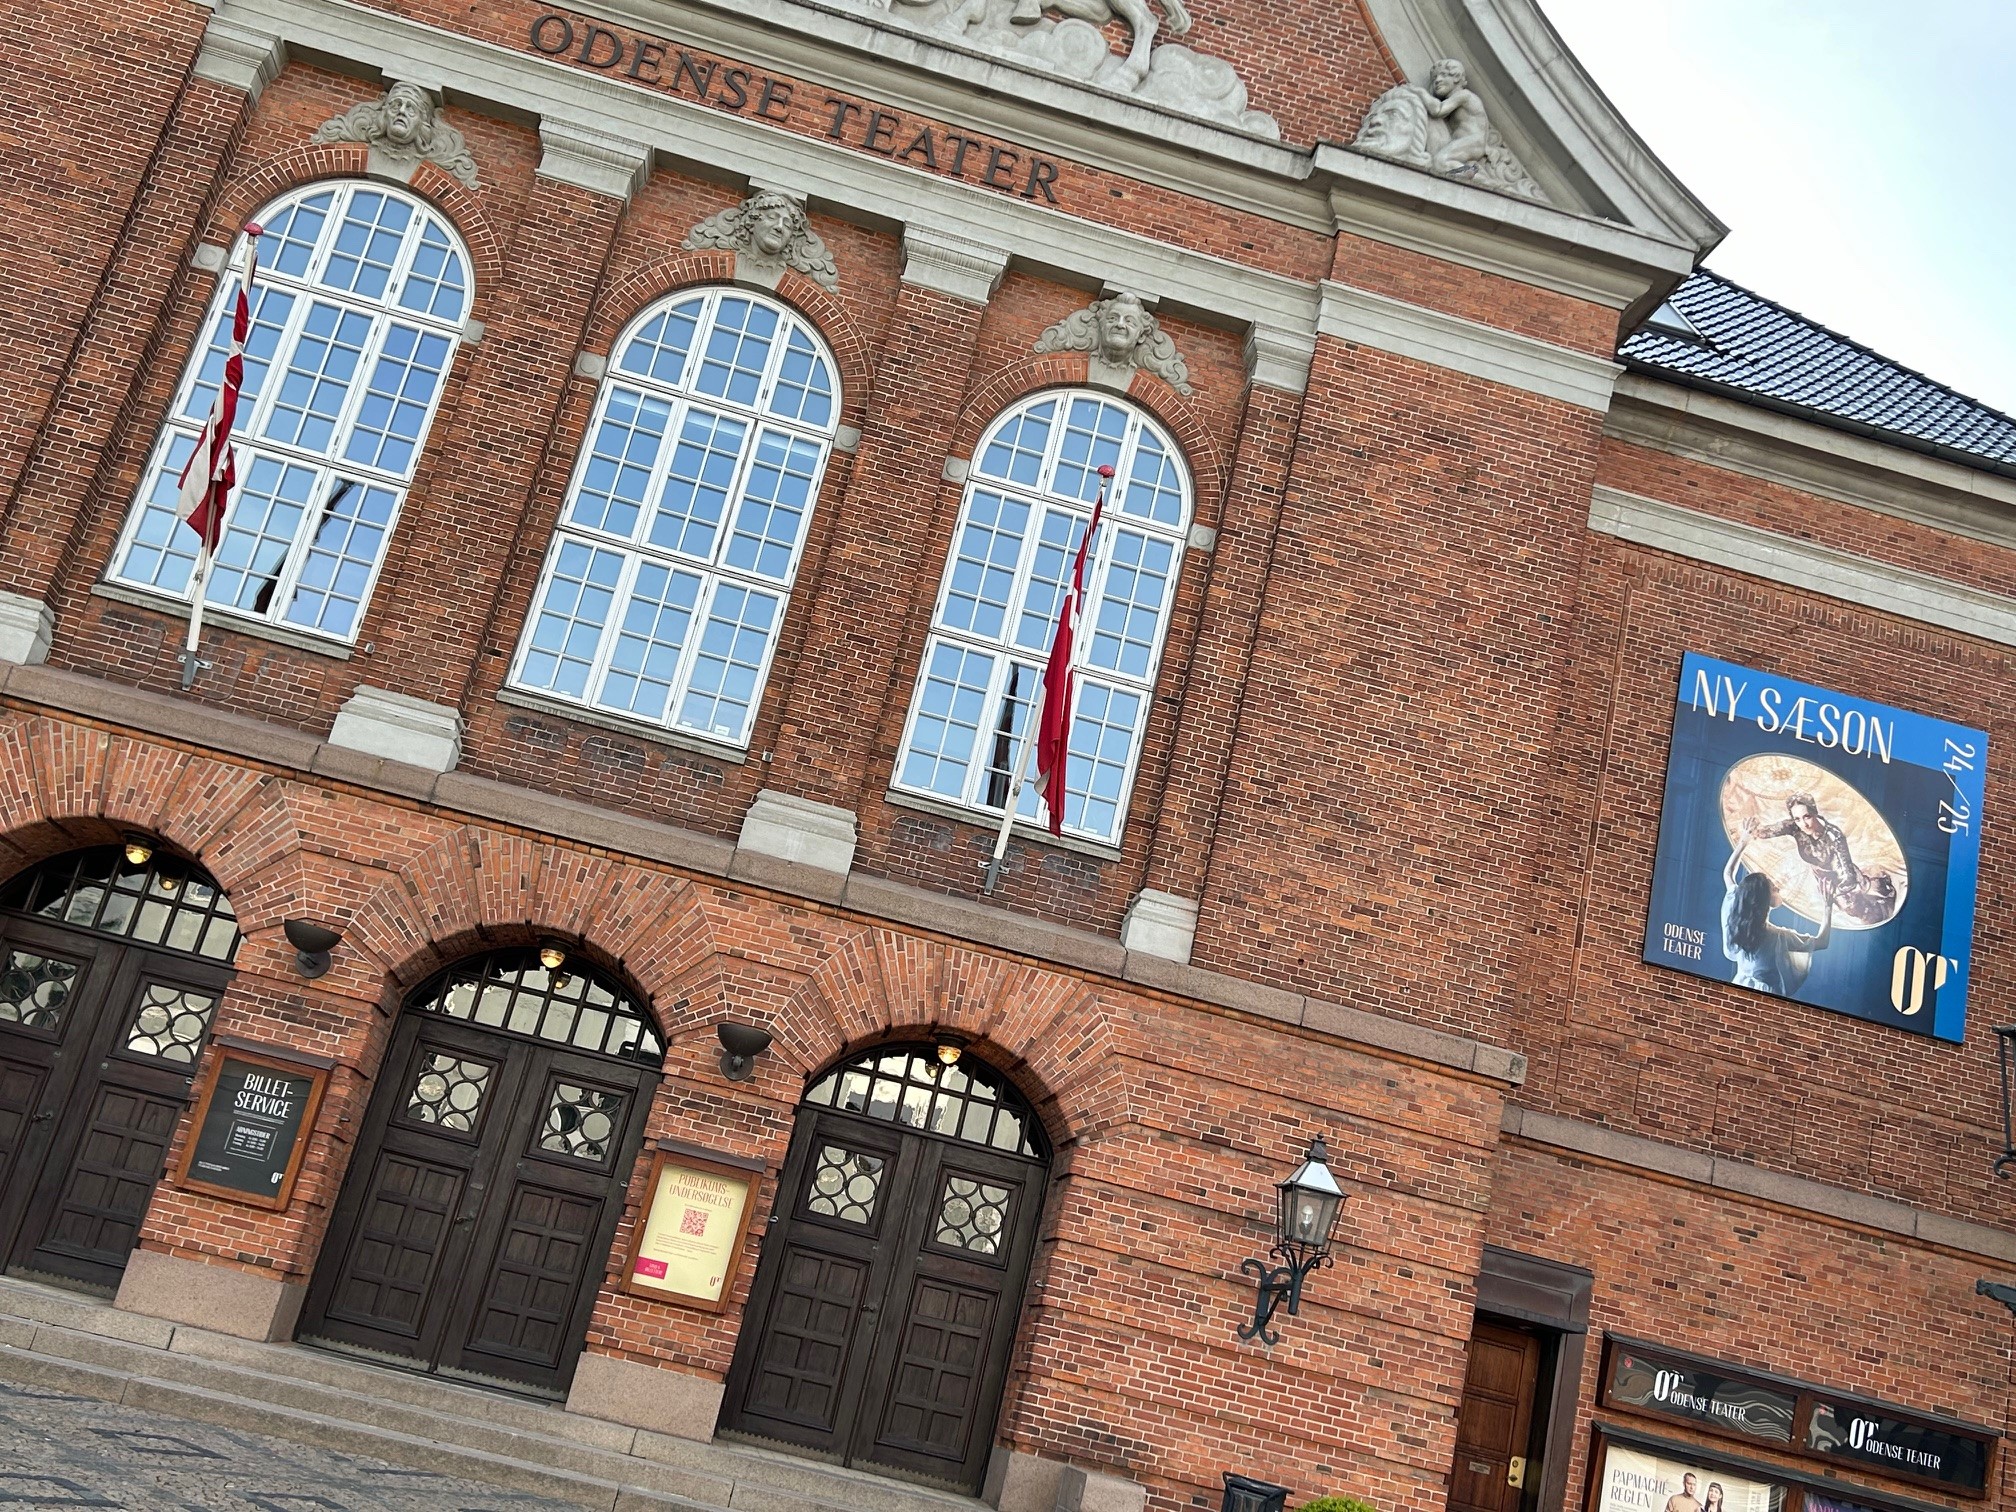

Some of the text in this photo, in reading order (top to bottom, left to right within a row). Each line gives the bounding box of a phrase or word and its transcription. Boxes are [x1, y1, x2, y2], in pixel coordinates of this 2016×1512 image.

[530, 14, 1060, 204] ODENSE TEATER
[1692, 669, 1895, 765] NY SÆSON
[1937, 738, 1976, 837] 24/25
[1662, 936, 1703, 961] TEATER
[1663, 922, 1708, 947] ODENSE
[243, 1073, 294, 1098] BILLET-
[234, 1090, 294, 1119] SERVICE
[1670, 1390, 1746, 1423] ODENSE TEATER
[1865, 1438, 1941, 1471] ODENSE TEATER
[1610, 1485, 1651, 1509] REGLEN
